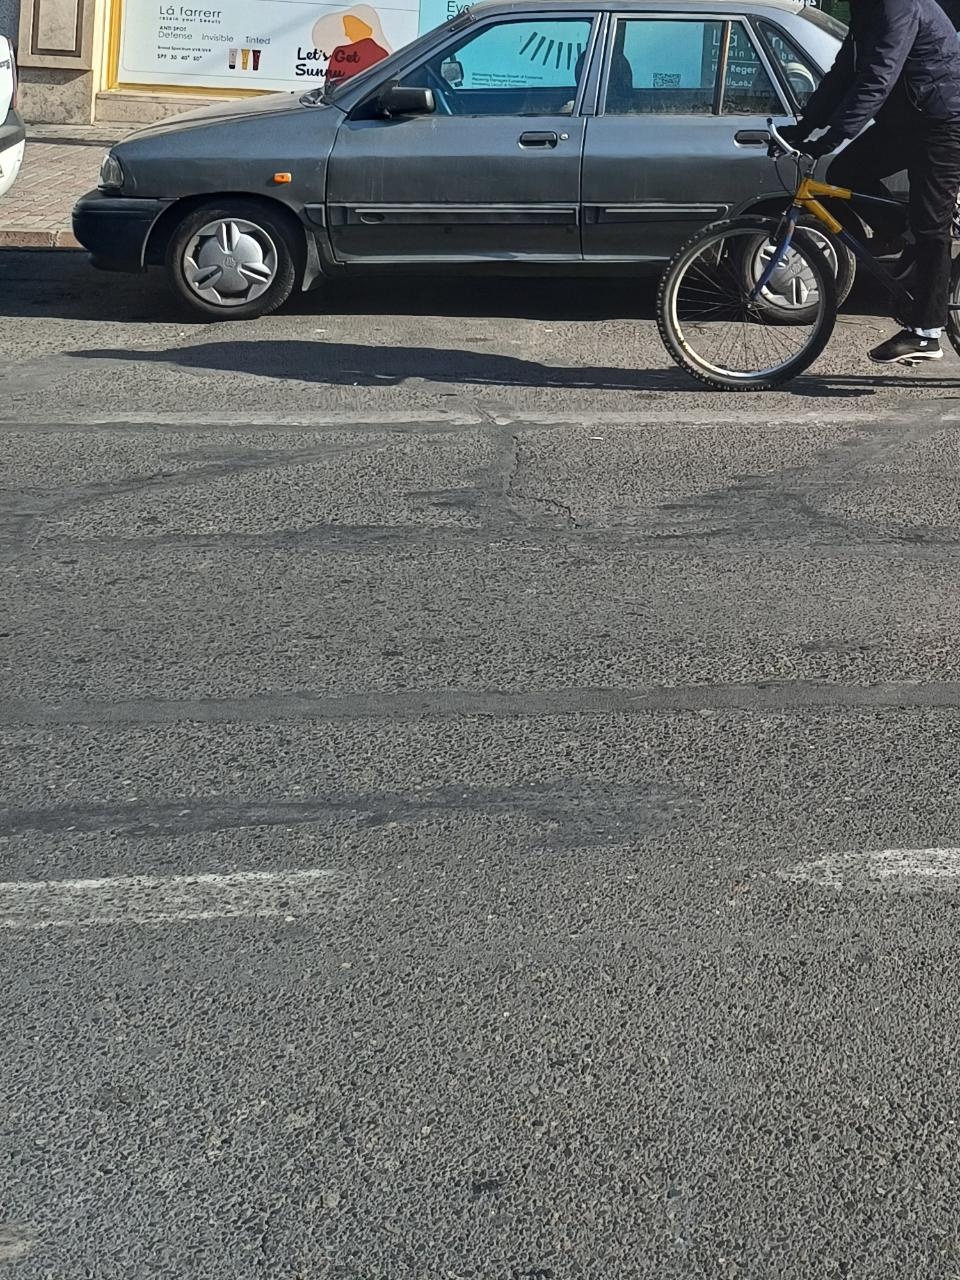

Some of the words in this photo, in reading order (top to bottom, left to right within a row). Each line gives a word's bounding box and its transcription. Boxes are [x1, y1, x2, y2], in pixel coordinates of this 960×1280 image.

[159, 5, 175, 16] Lá
[180, 7, 222, 18] farrerr
[158, 30, 193, 40] Defense
[201, 33, 234, 42] Invisible
[245, 35, 271, 45] Tinted
[297, 47, 331, 61] Let's
[335, 49, 361, 63] Get
